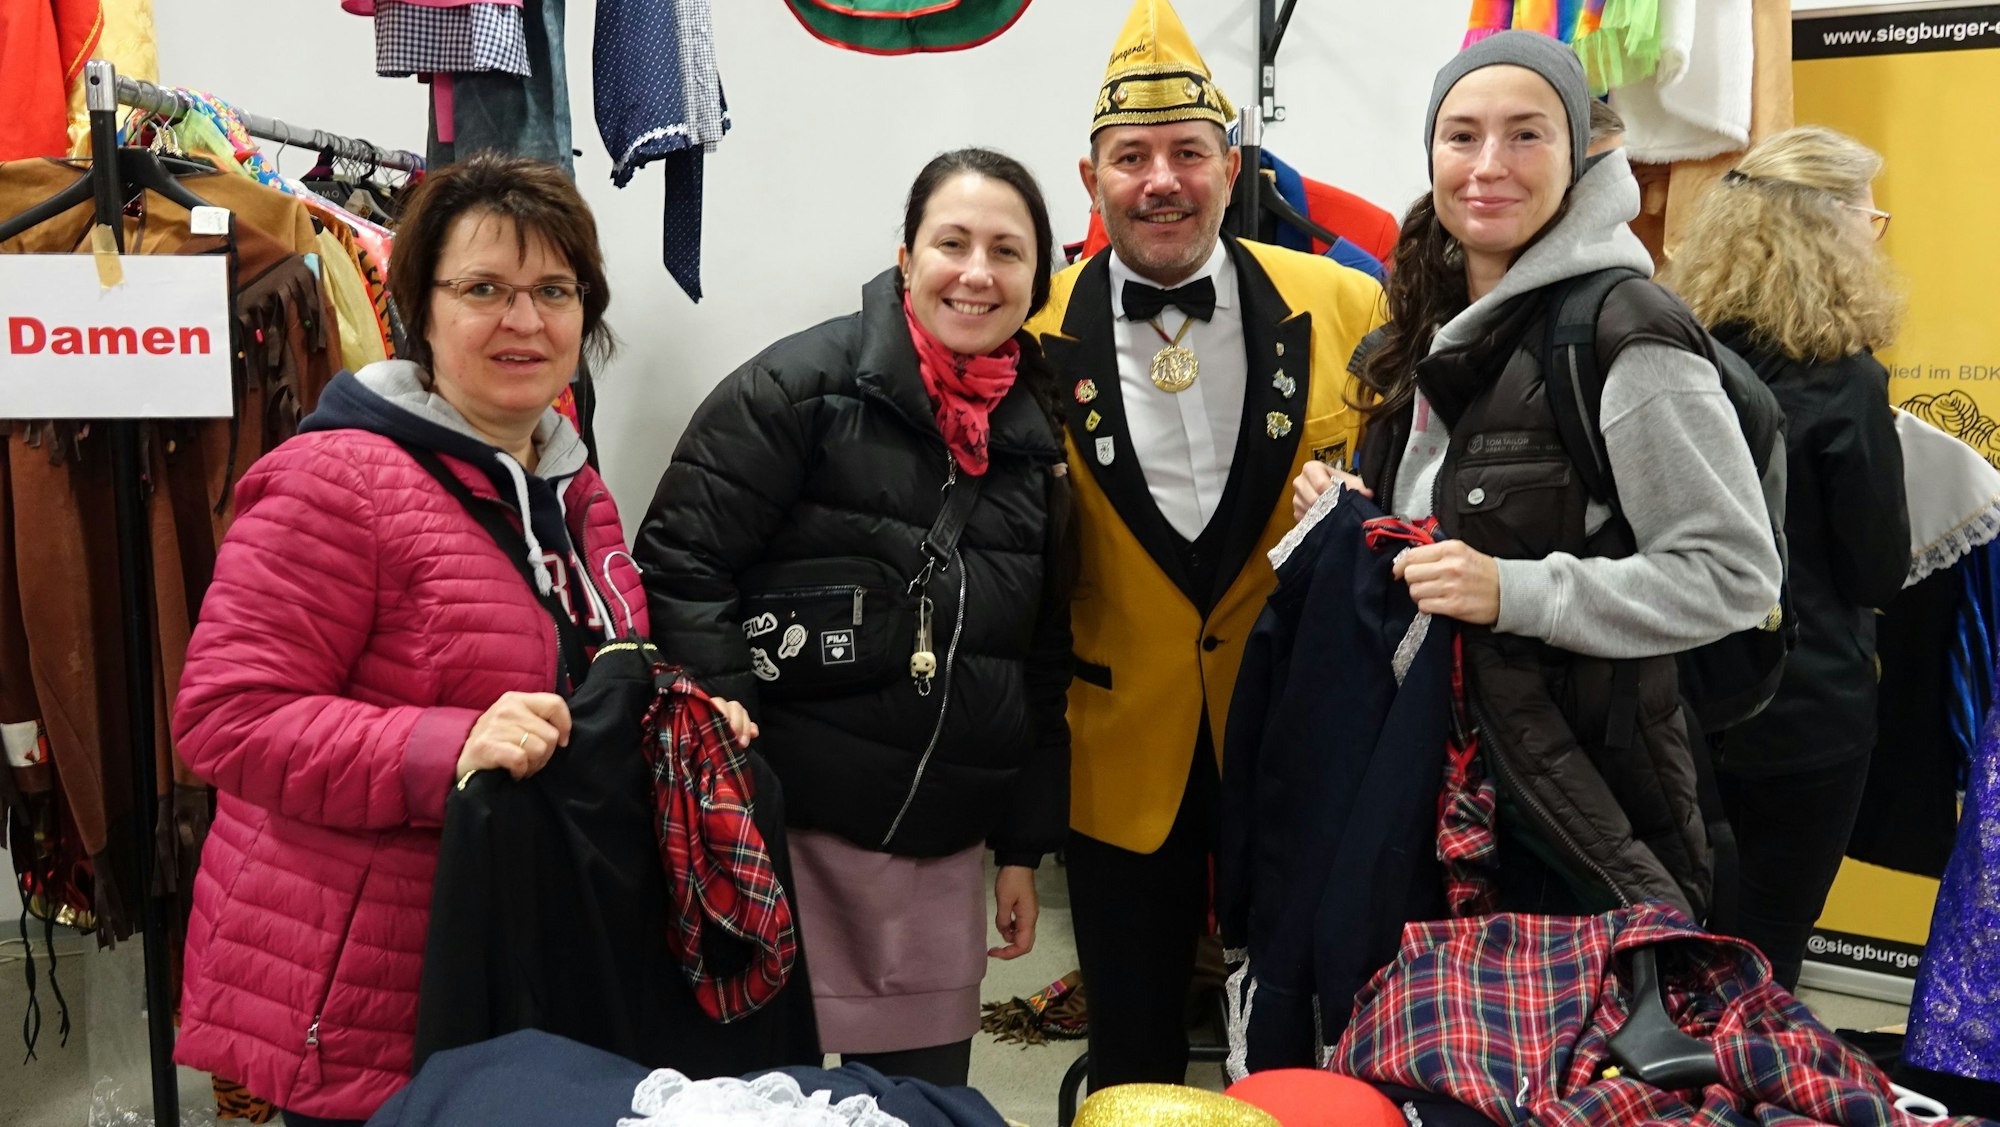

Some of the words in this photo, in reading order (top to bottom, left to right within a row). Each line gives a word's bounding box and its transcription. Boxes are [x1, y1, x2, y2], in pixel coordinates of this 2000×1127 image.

[8, 316, 211, 354] Damen
[1929, 365, 1951, 379] im
[1959, 365, 2000, 381] BDK
[1503, 438, 1529, 446] TAILOR
[744, 616, 774, 638] FILA
[826, 634, 849, 644] FILA
[1807, 935, 1922, 969] @siegburge
